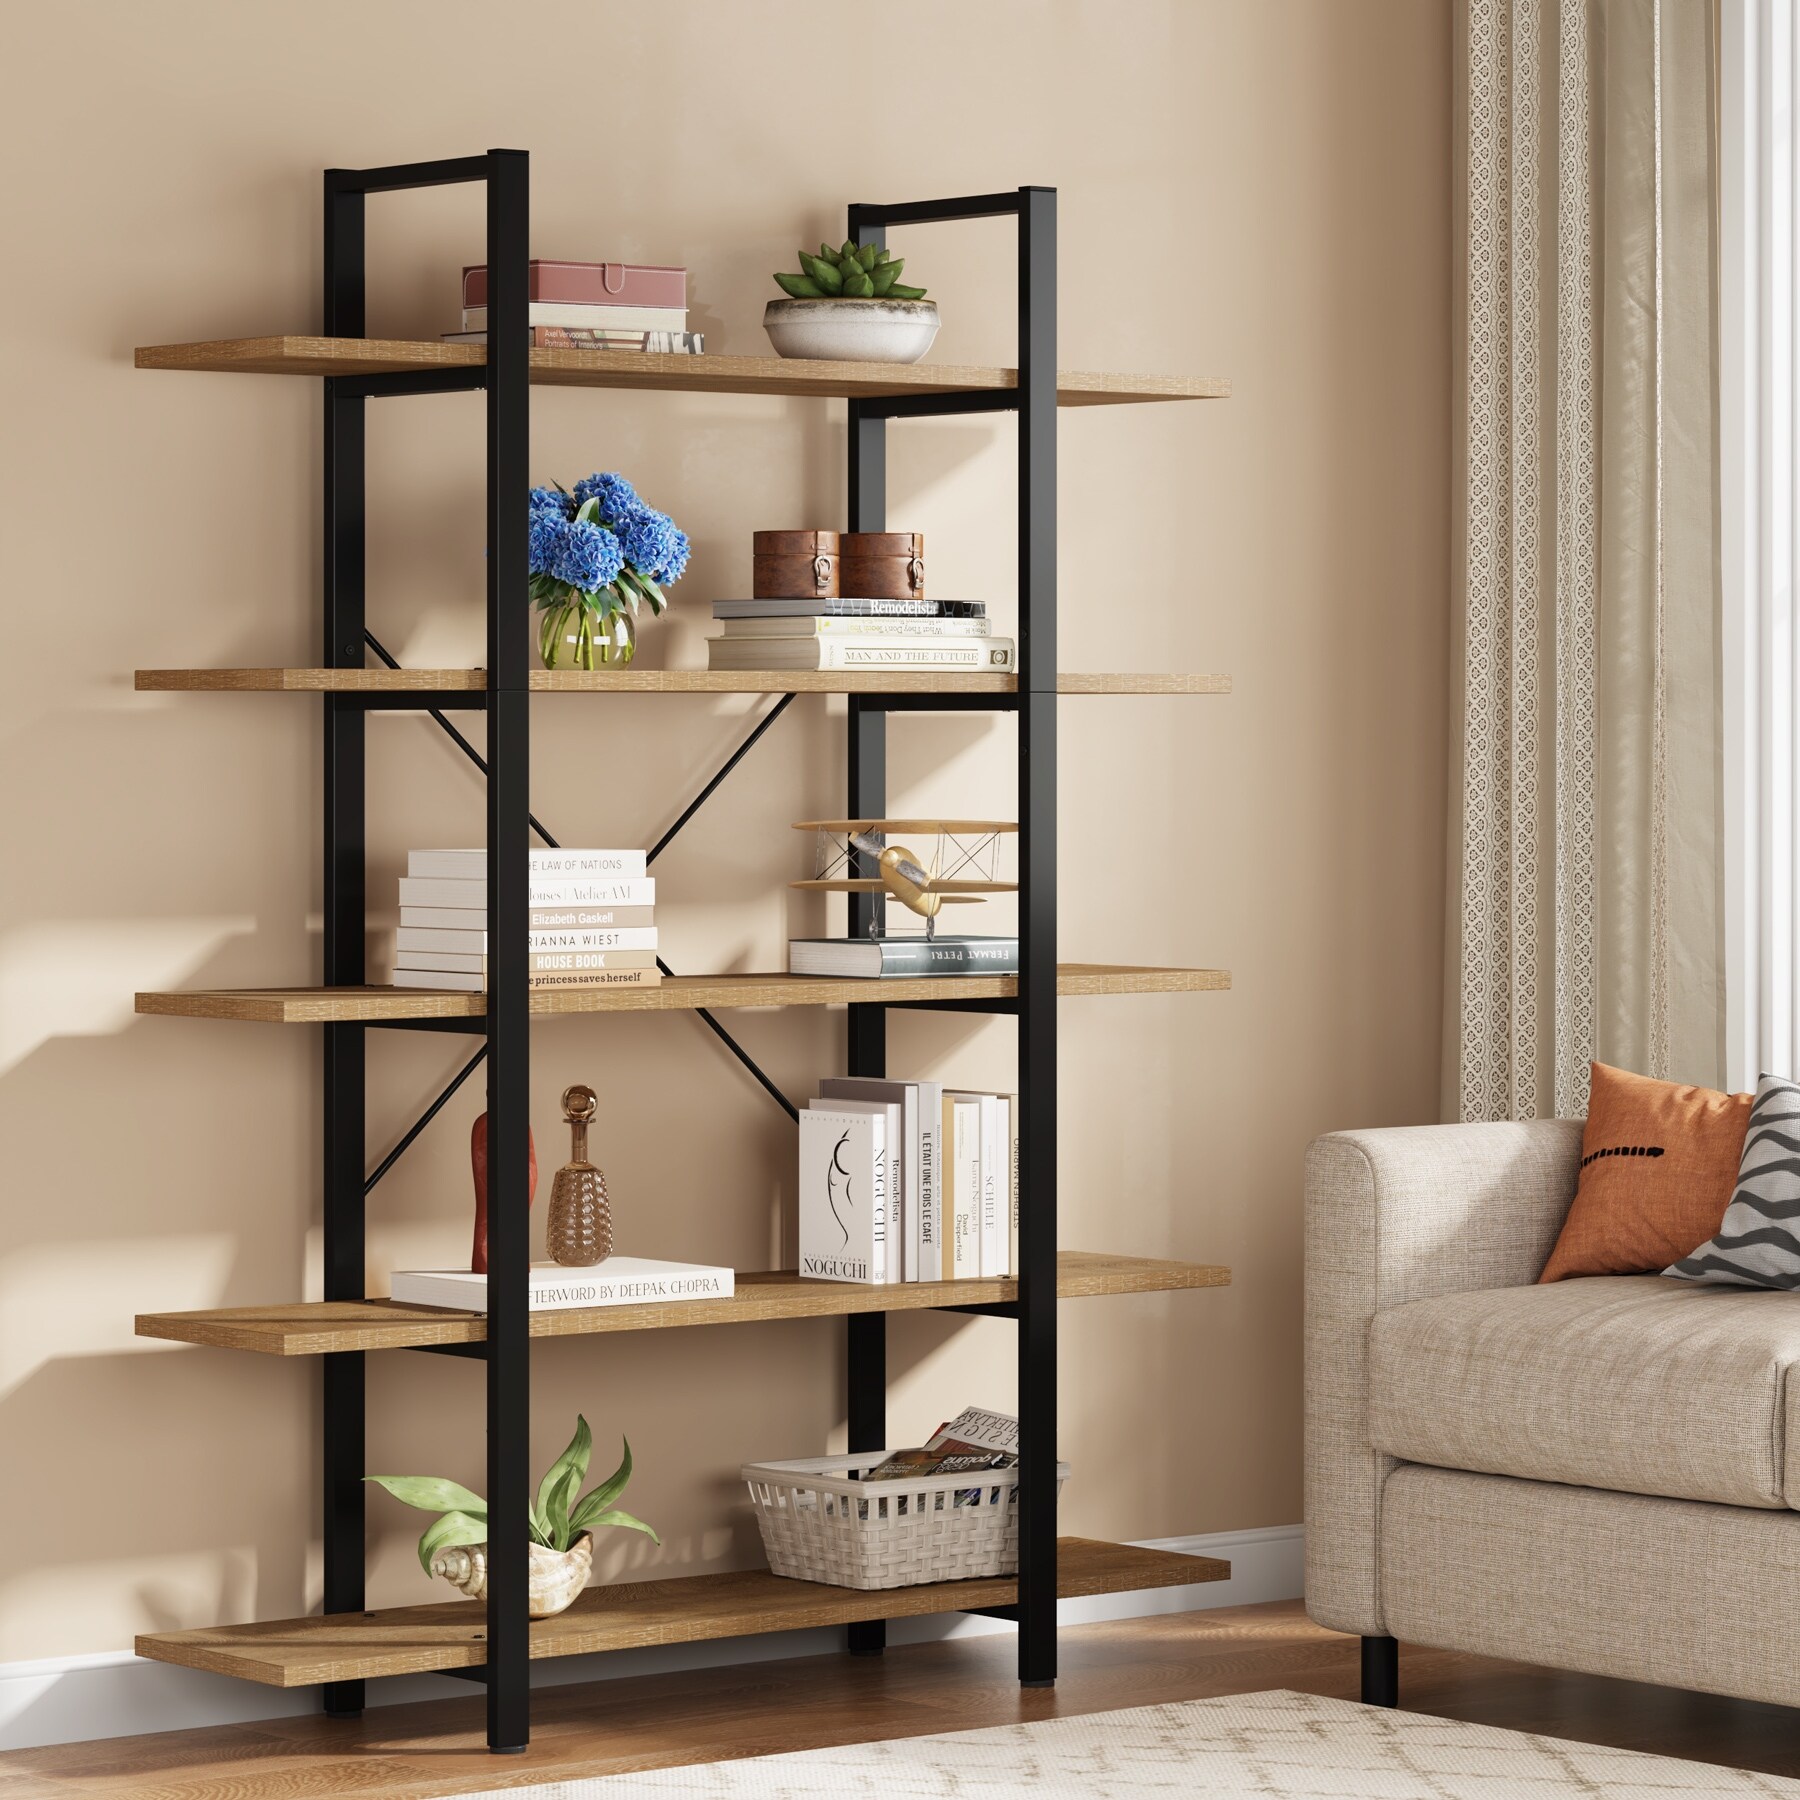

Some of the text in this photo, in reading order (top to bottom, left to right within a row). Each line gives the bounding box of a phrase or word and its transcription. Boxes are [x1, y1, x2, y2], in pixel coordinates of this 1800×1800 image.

[544, 329, 559, 338] Axel
[544, 339, 604, 350] Portraits of Interiors
[870, 600, 938, 615] Remodelista
[904, 624, 921, 634] They
[922, 626, 943, 635] What
[844, 652, 979, 662] MAN AND THE FUTURE
[541, 860, 562, 871] LAW
[565, 860, 577, 870] OF
[580, 859, 622, 870] NATIONS
[529, 887, 561, 901] ouses
[573, 885, 607, 900] Atelier
[532, 911, 613, 925] Elizabeth Gaskell
[529, 934, 620, 947] RIANNA WIEST
[537, 954, 605, 969] HOUSE BOOK
[931, 950, 1009, 961] FERMAT PETRI
[535, 974, 578, 987] princess
[578, 974, 606, 983] saves
[606, 972, 642, 983] herself
[874, 1149, 885, 1242] NOGUCHI
[892, 1159, 900, 1222] Remodelista
[923, 1132, 933, 1244] IL ÉTAIT UNE FOIS LE CAFÉ
[970, 1159, 979, 1233] Isamu Noguchi
[985, 1175, 994, 1230] SCHIELE
[955, 1214, 963, 1262] Chipperfield
[803, 1257, 867, 1279] NOGUCHI
[600, 1284, 616, 1298] BY
[619, 1282, 666, 1298] DEEPAK
[670, 1278, 720, 1293] CHOPRA
